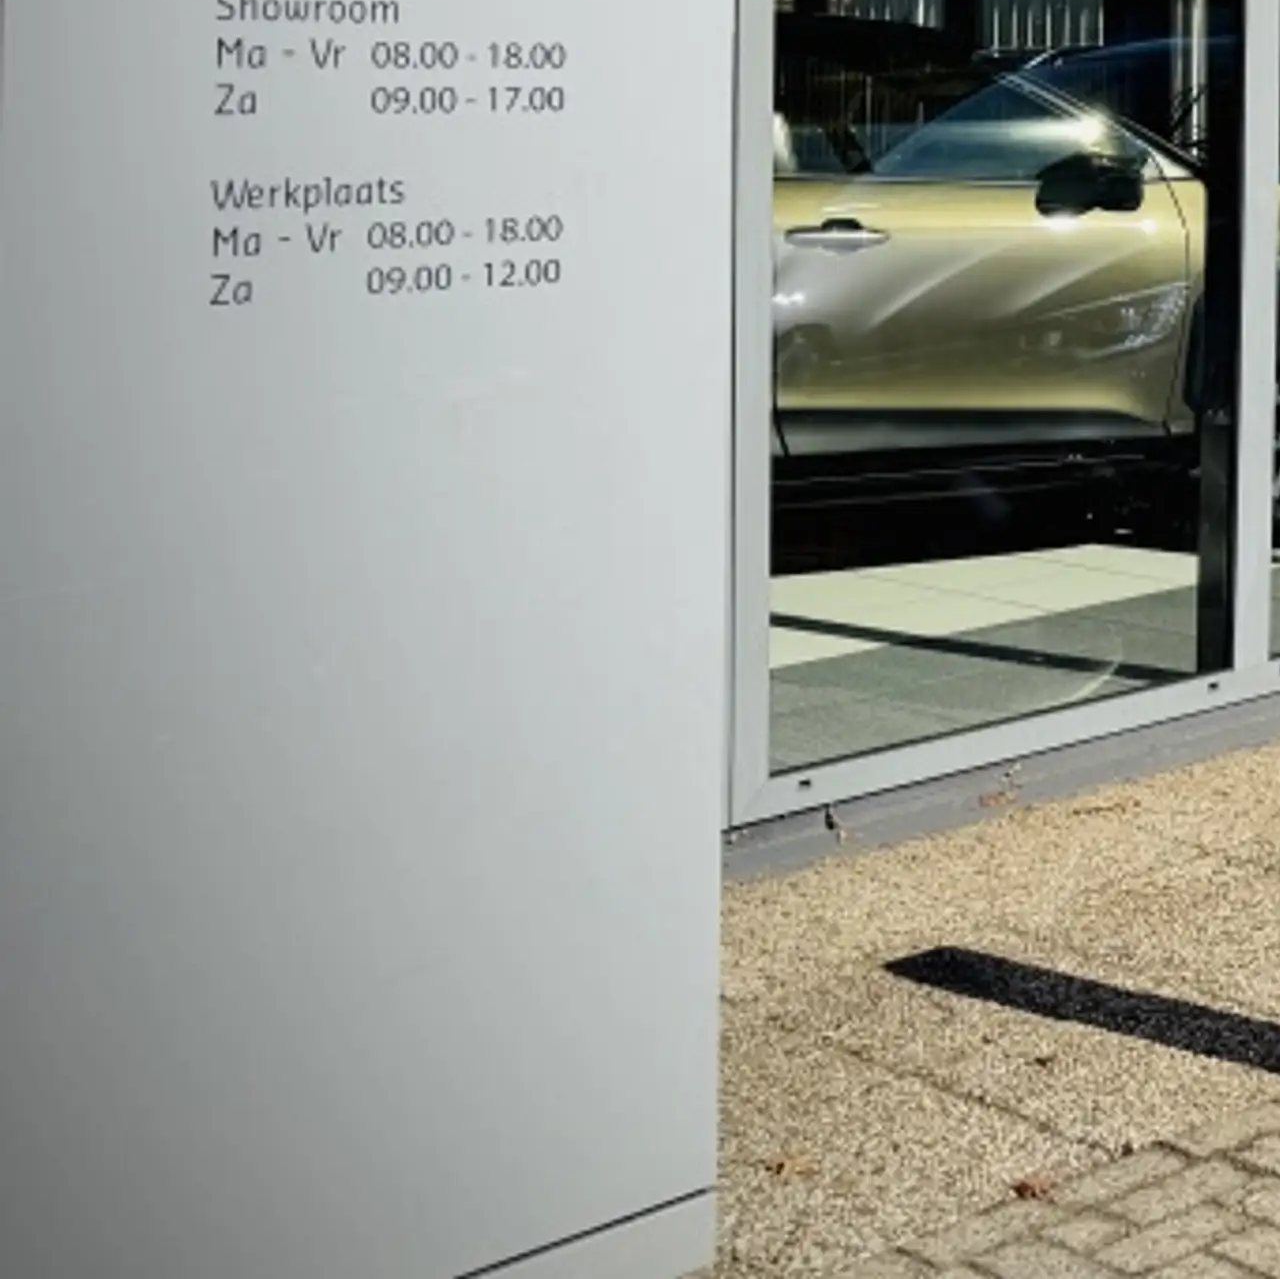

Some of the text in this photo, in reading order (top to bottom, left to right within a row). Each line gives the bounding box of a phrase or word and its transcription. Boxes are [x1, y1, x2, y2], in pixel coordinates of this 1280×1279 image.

[216, 37, 268, 70] Ma
[308, 37, 348, 70] Vr
[370, 40, 460, 71] 08.00
[486, 41, 569, 71] 18.00
[214, 82, 258, 117] Za
[370, 85, 459, 116] 09.00
[488, 86, 566, 115] 17.00
[209, 176, 407, 214] Werkplaats
[212, 226, 263, 258] Ma
[304, 222, 344, 255] Vr
[366, 219, 456, 251] 08.00
[485, 214, 565, 246] 18.00
[209, 273, 254, 306] Za
[366, 264, 454, 295] 09.00
[483, 258, 562, 288] 12.00
